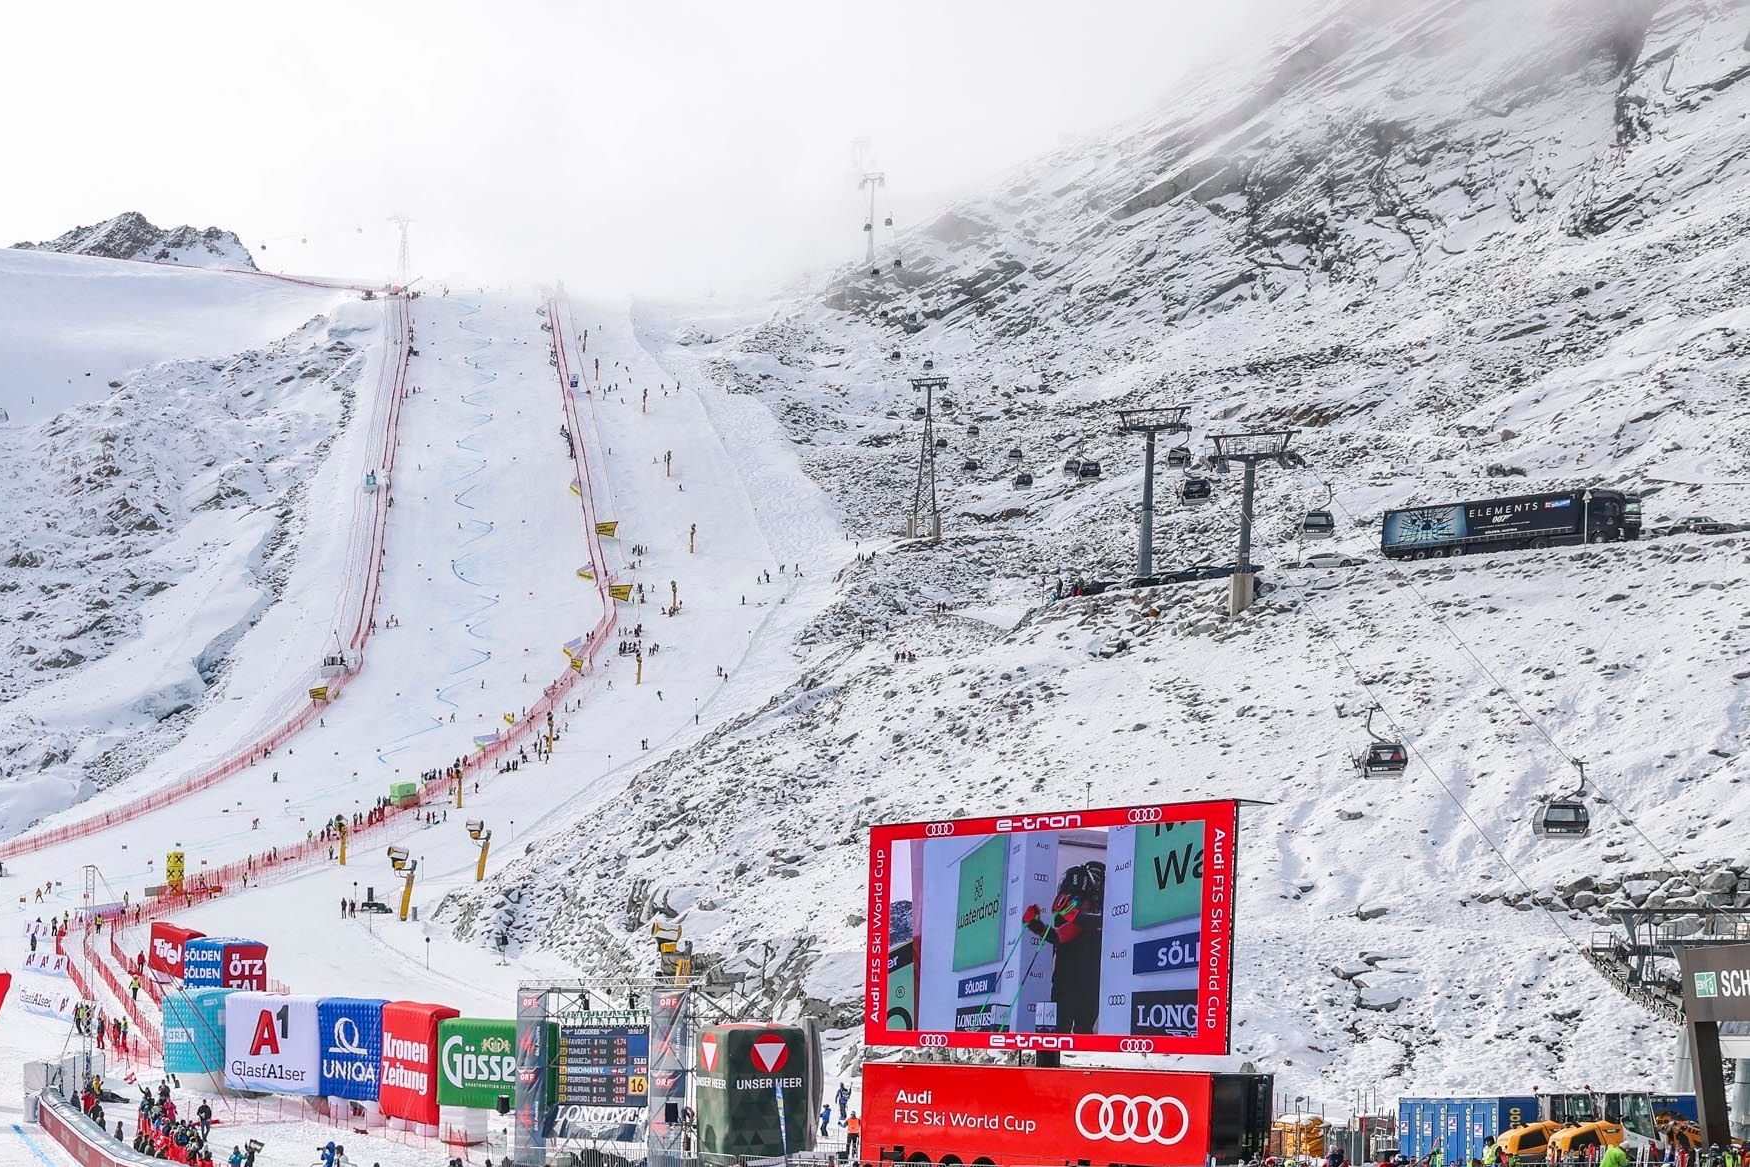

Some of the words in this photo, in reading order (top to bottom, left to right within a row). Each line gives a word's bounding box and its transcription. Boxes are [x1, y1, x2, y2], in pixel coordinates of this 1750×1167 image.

[1469, 502, 1538, 518] ELEMENTS
[996, 814, 1081, 832] e-tron
[1213, 828, 1225, 868] Audi
[875, 848, 886, 878] Cup
[1115, 860, 1131, 872] Audi
[1212, 876, 1223, 903] FIS
[873, 882, 883, 928] World
[957, 896, 1000, 929] waterdrop
[1211, 909, 1222, 933] Ski
[154, 938, 182, 966] Tirol
[185, 947, 220, 962] SÖLDEN
[872, 933, 882, 955] Ski
[1110, 950, 1127, 960] Audi
[184, 968, 220, 979] SÖLDEN
[229, 954, 263, 976] ÖTZ
[871, 959, 881, 981] FIS
[1208, 938, 1221, 991] World
[965, 979, 988, 994] SÖLDEN
[523, 998, 538, 1006] ORF
[660, 998, 678, 1006] ORF
[870, 988, 879, 1023] Audi
[1205, 996, 1219, 1029] Cup
[249, 1004, 289, 1055] A1
[384, 1031, 428, 1064] Kronen
[990, 1034, 1074, 1049] e-tron
[231, 1061, 305, 1081] GlasfA1ser
[322, 1058, 375, 1082] UNIQA
[442, 1035, 516, 1089] Gösse
[382, 1060, 428, 1095] Zeitung
[631, 1079, 643, 1092] 16
[655, 1078, 673, 1087] ORF
[736, 1078, 773, 1090] UNSER
[775, 1077, 803, 1089] HEER
[896, 1090, 932, 1105] Audi
[894, 1109, 918, 1124] FIS
[923, 1111, 945, 1126] Ski
[950, 1112, 999, 1129] World
[1004, 1116, 1036, 1134] Cup
